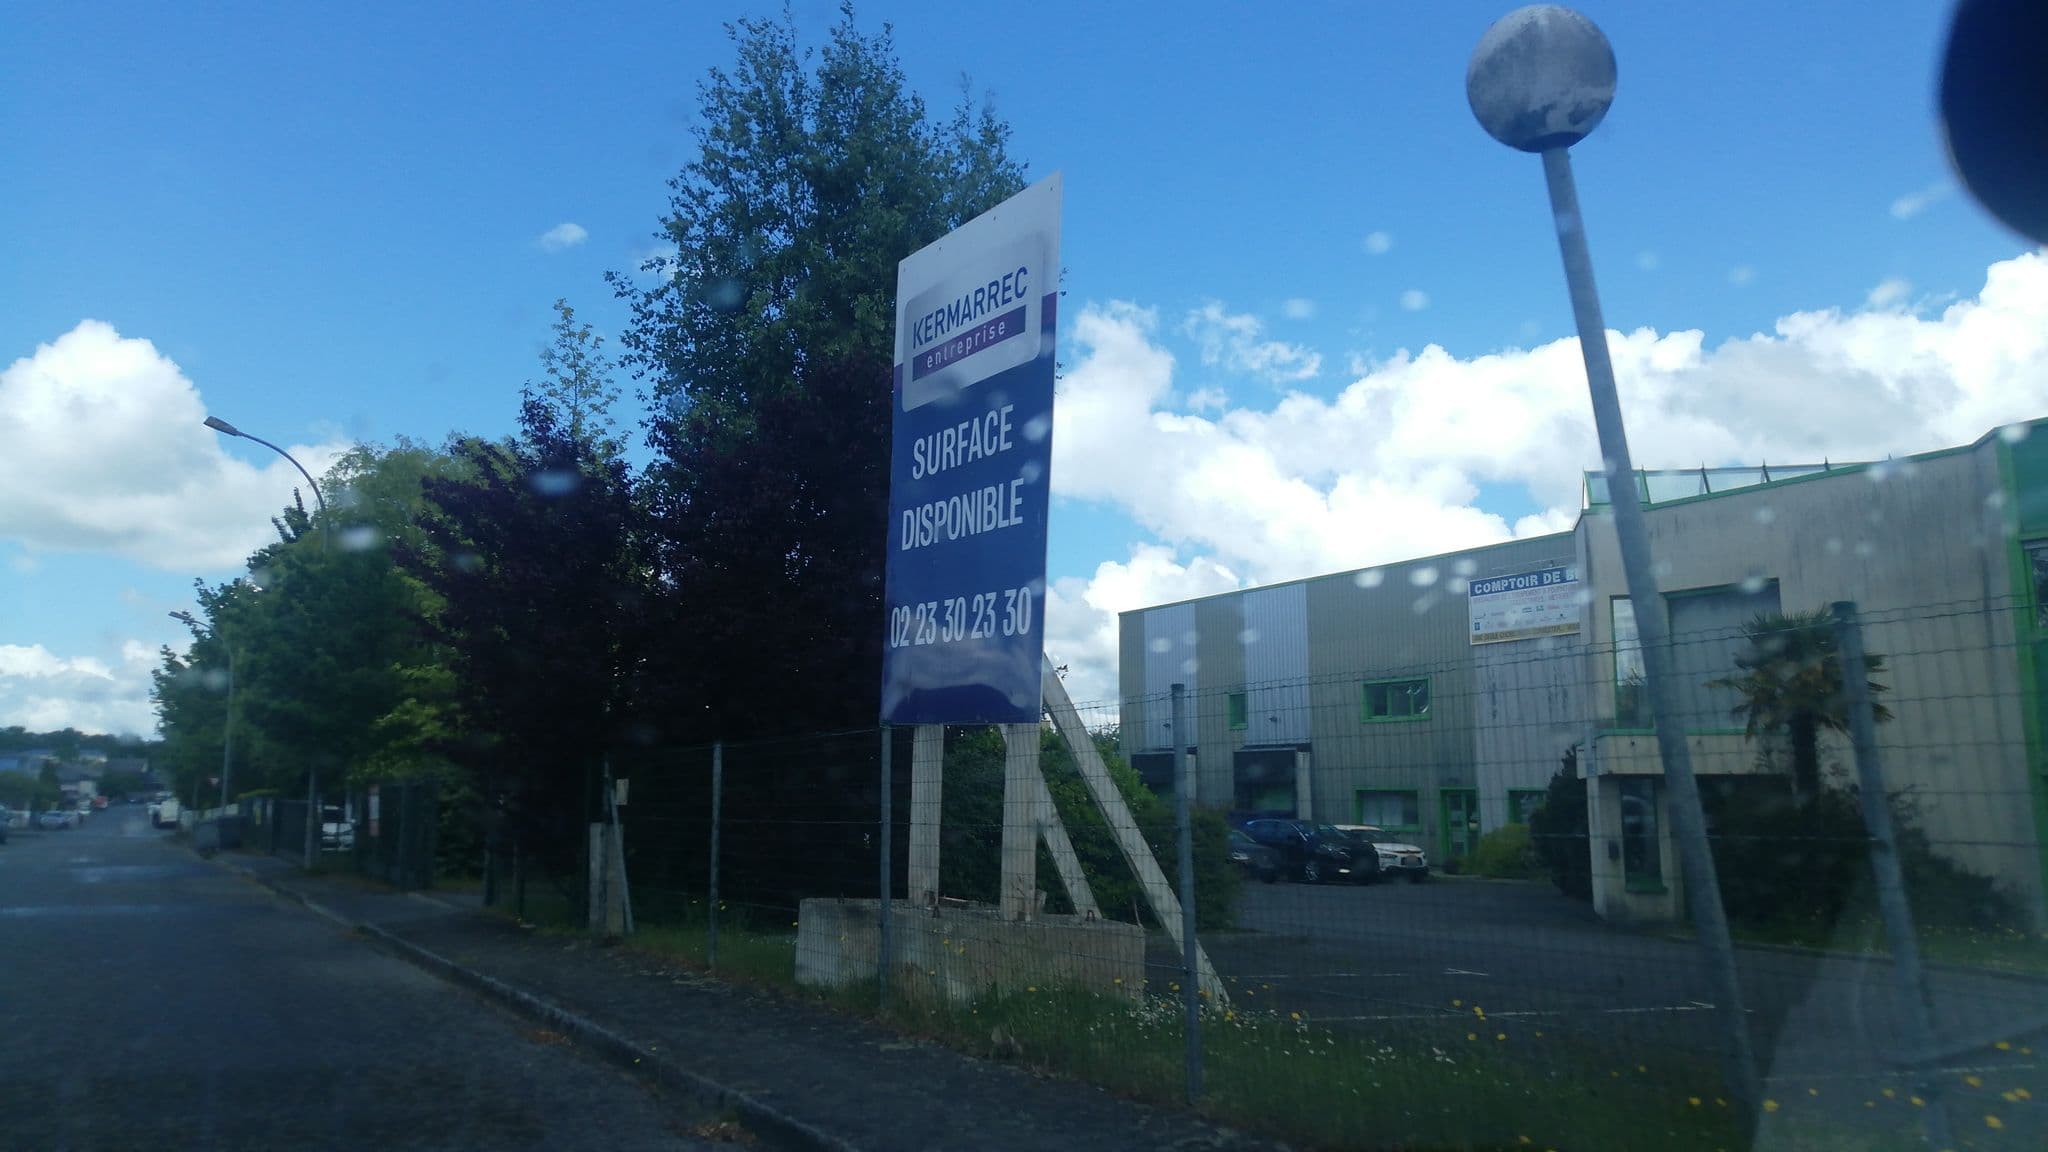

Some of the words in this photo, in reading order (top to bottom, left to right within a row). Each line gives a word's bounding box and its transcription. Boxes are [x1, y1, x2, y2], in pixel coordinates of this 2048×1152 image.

[912, 266, 1028, 349] KERMARREC
[926, 320, 1007, 369] entreprise
[912, 404, 1014, 480] SURFACE
[901, 478, 1025, 551] DISPONIBLE
[1474, 574, 1538, 594] COMPTOIR
[1543, 571, 1561, 584] DE
[890, 605, 910, 649] 02
[914, 601, 938, 645] 23
[942, 596, 967, 643] 30
[971, 592, 997, 639] 23
[1003, 586, 1032, 637] 30
